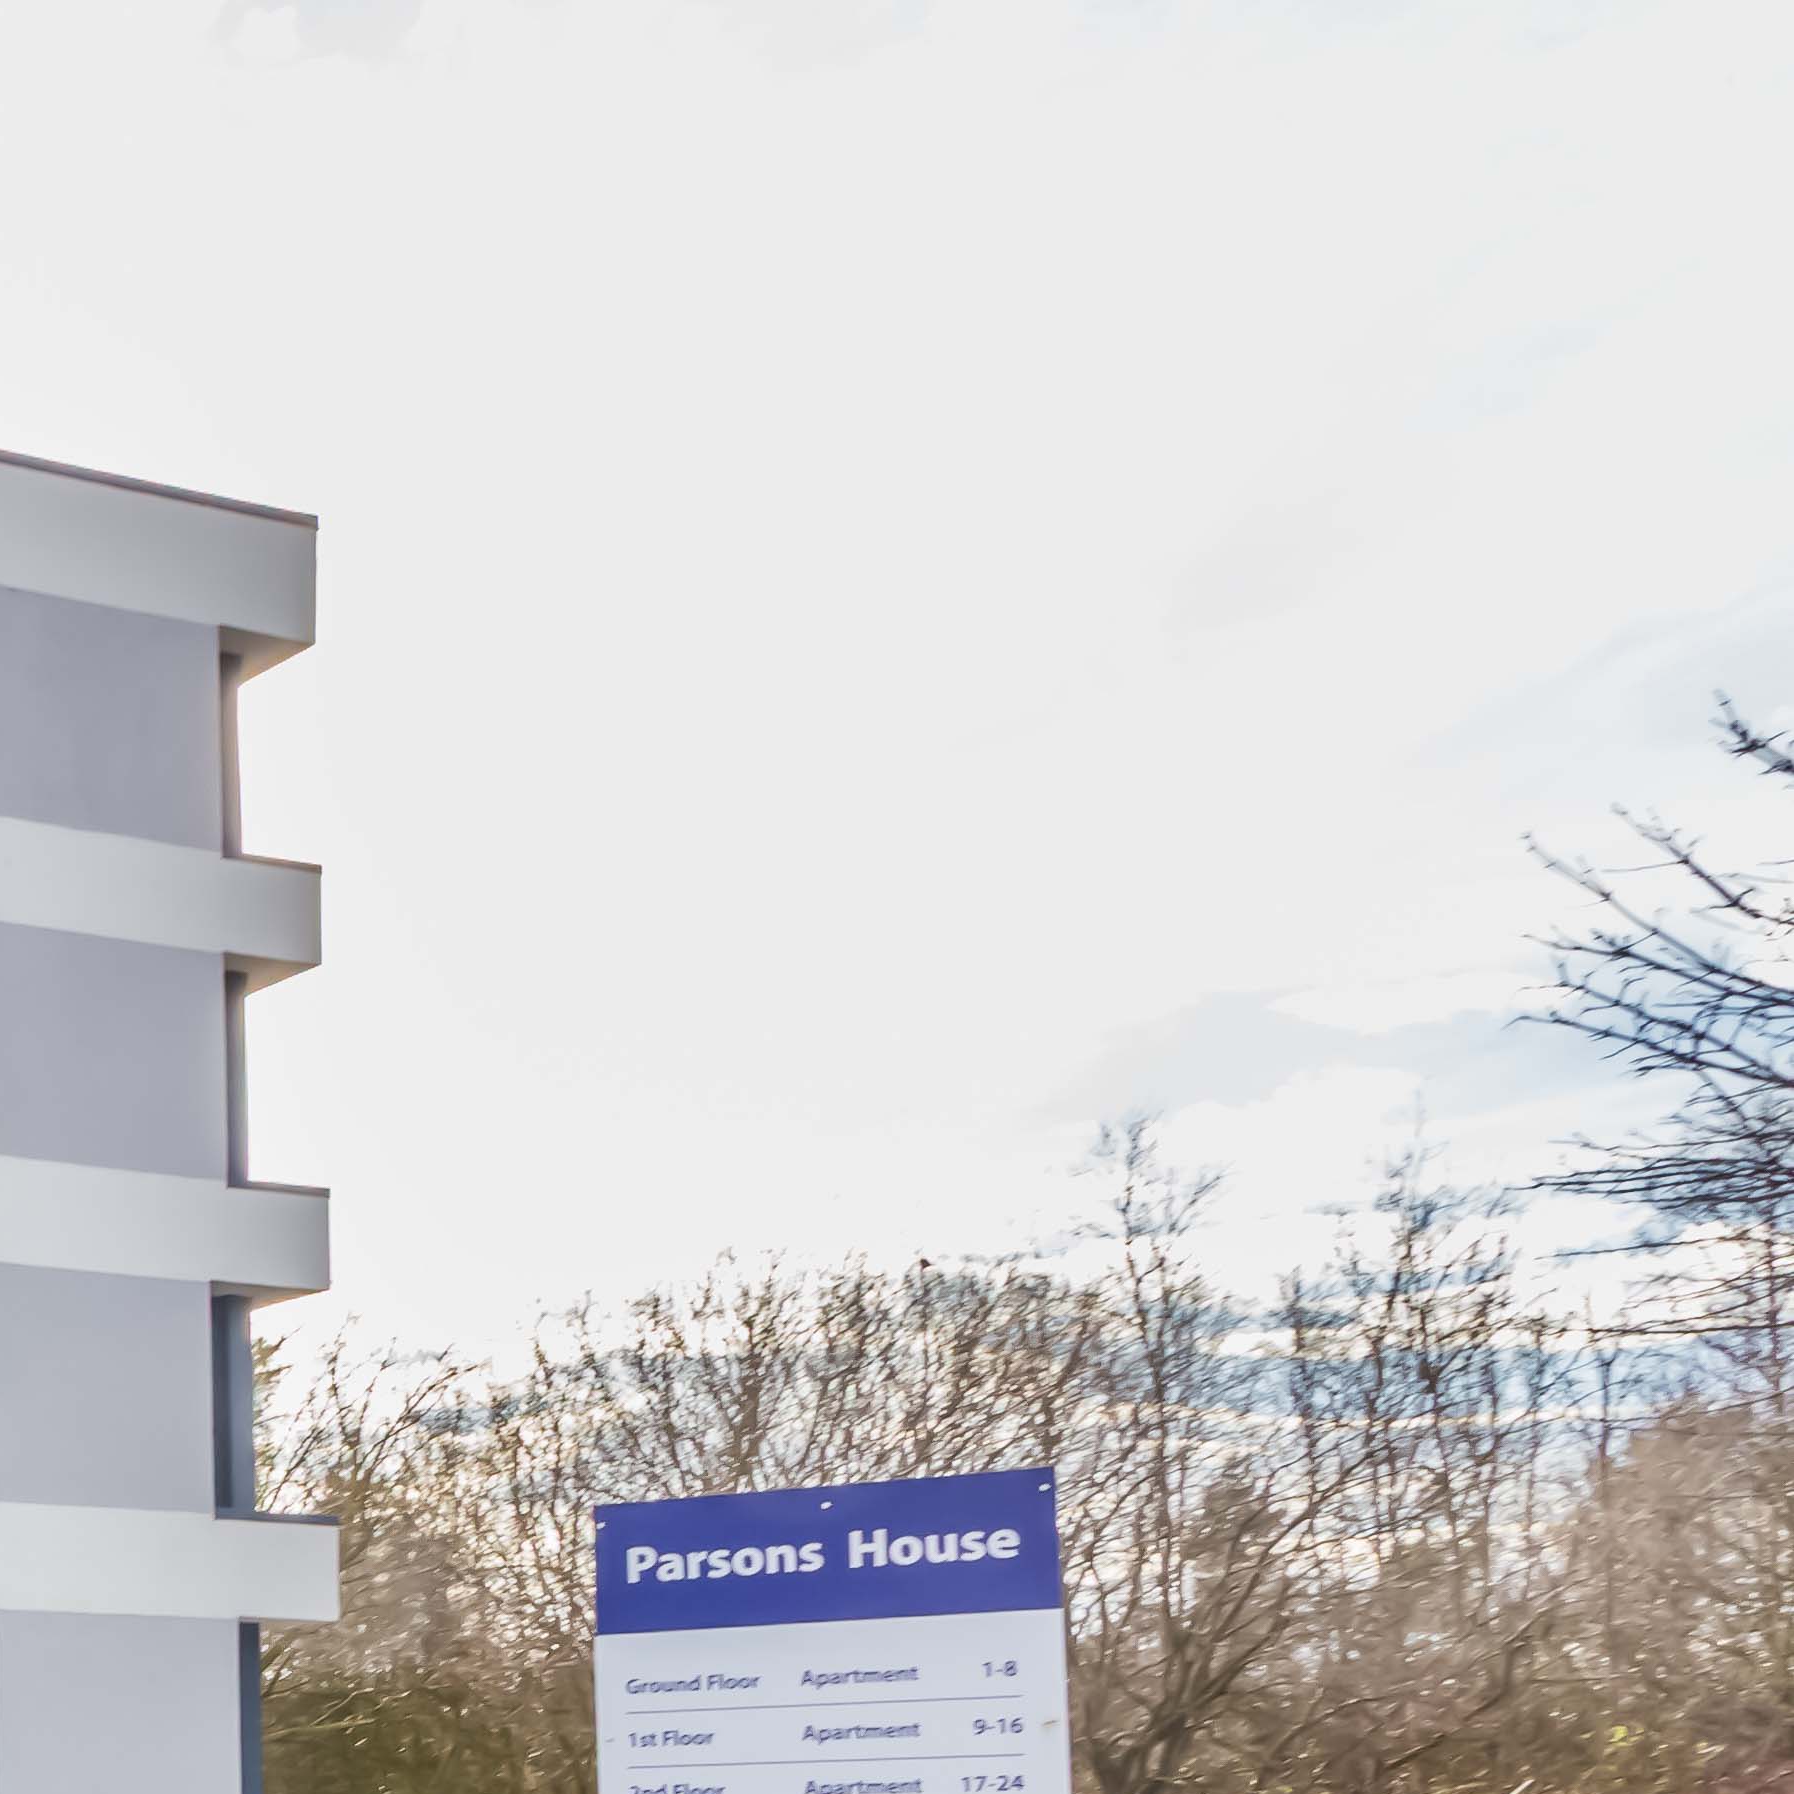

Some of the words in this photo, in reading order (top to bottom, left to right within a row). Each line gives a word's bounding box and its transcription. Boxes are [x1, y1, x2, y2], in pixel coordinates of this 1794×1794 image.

[627, 1543, 824, 1583] Parsons
[849, 1529, 1020, 1568] House
[625, 1675, 701, 1694] Ground
[707, 1674, 760, 1690] Floor
[801, 1667, 919, 1689] Apartment
[982, 1660, 1018, 1677] 1-8
[628, 1733, 657, 1747] 1st
[662, 1730, 714, 1746] Floor
[802, 1723, 921, 1745] Apartment
[973, 1717, 1023, 1735] 9-16
[961, 1775, 1025, 1792] 17-24
